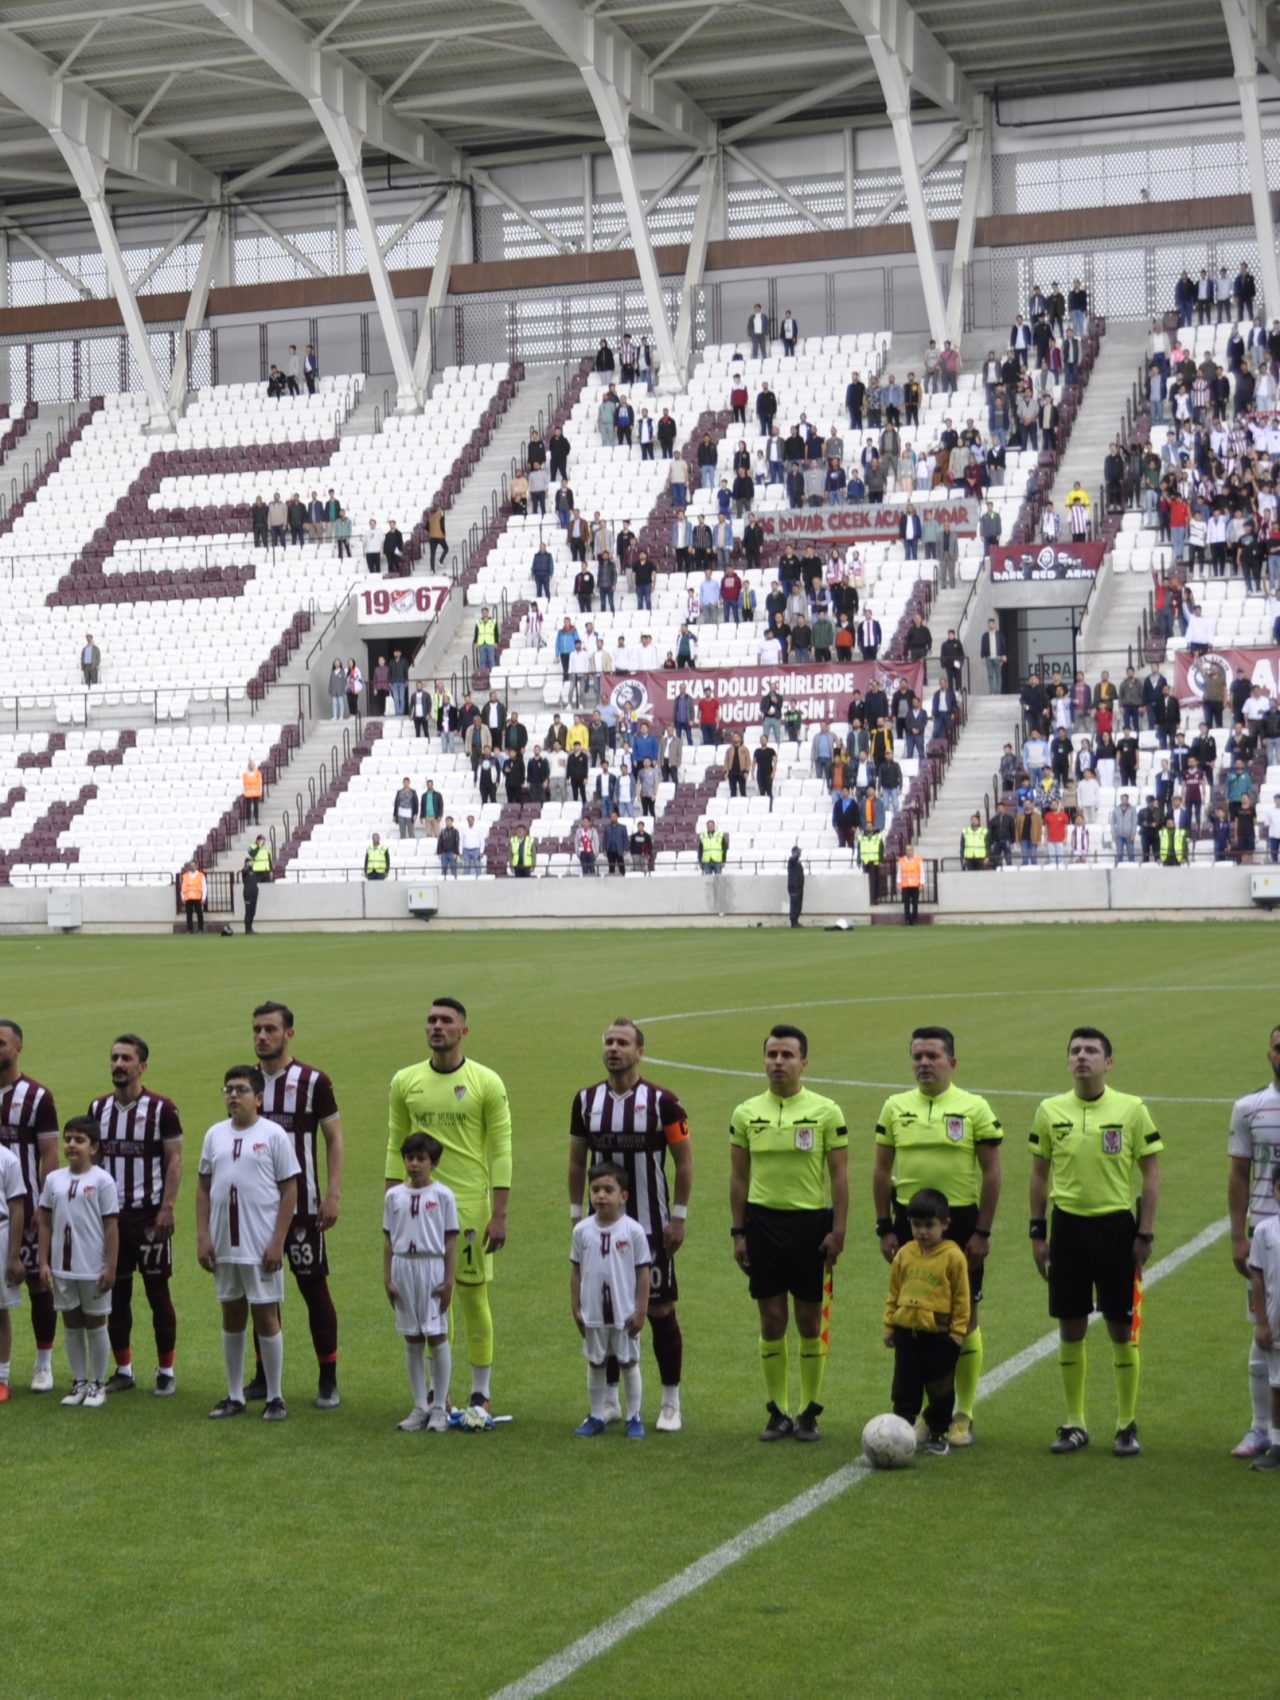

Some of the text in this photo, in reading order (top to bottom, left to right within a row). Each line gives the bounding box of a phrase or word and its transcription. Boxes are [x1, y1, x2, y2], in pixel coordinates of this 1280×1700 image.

[779, 512, 825, 533] DUVAR
[993, 570, 1025, 581] DARK
[1032, 569, 1057, 580] RED
[718, 676, 759, 699] DOLU
[140, 1243, 163, 1266] 77
[290, 1243, 313, 1265] 53
[462, 1243, 472, 1266] 1
